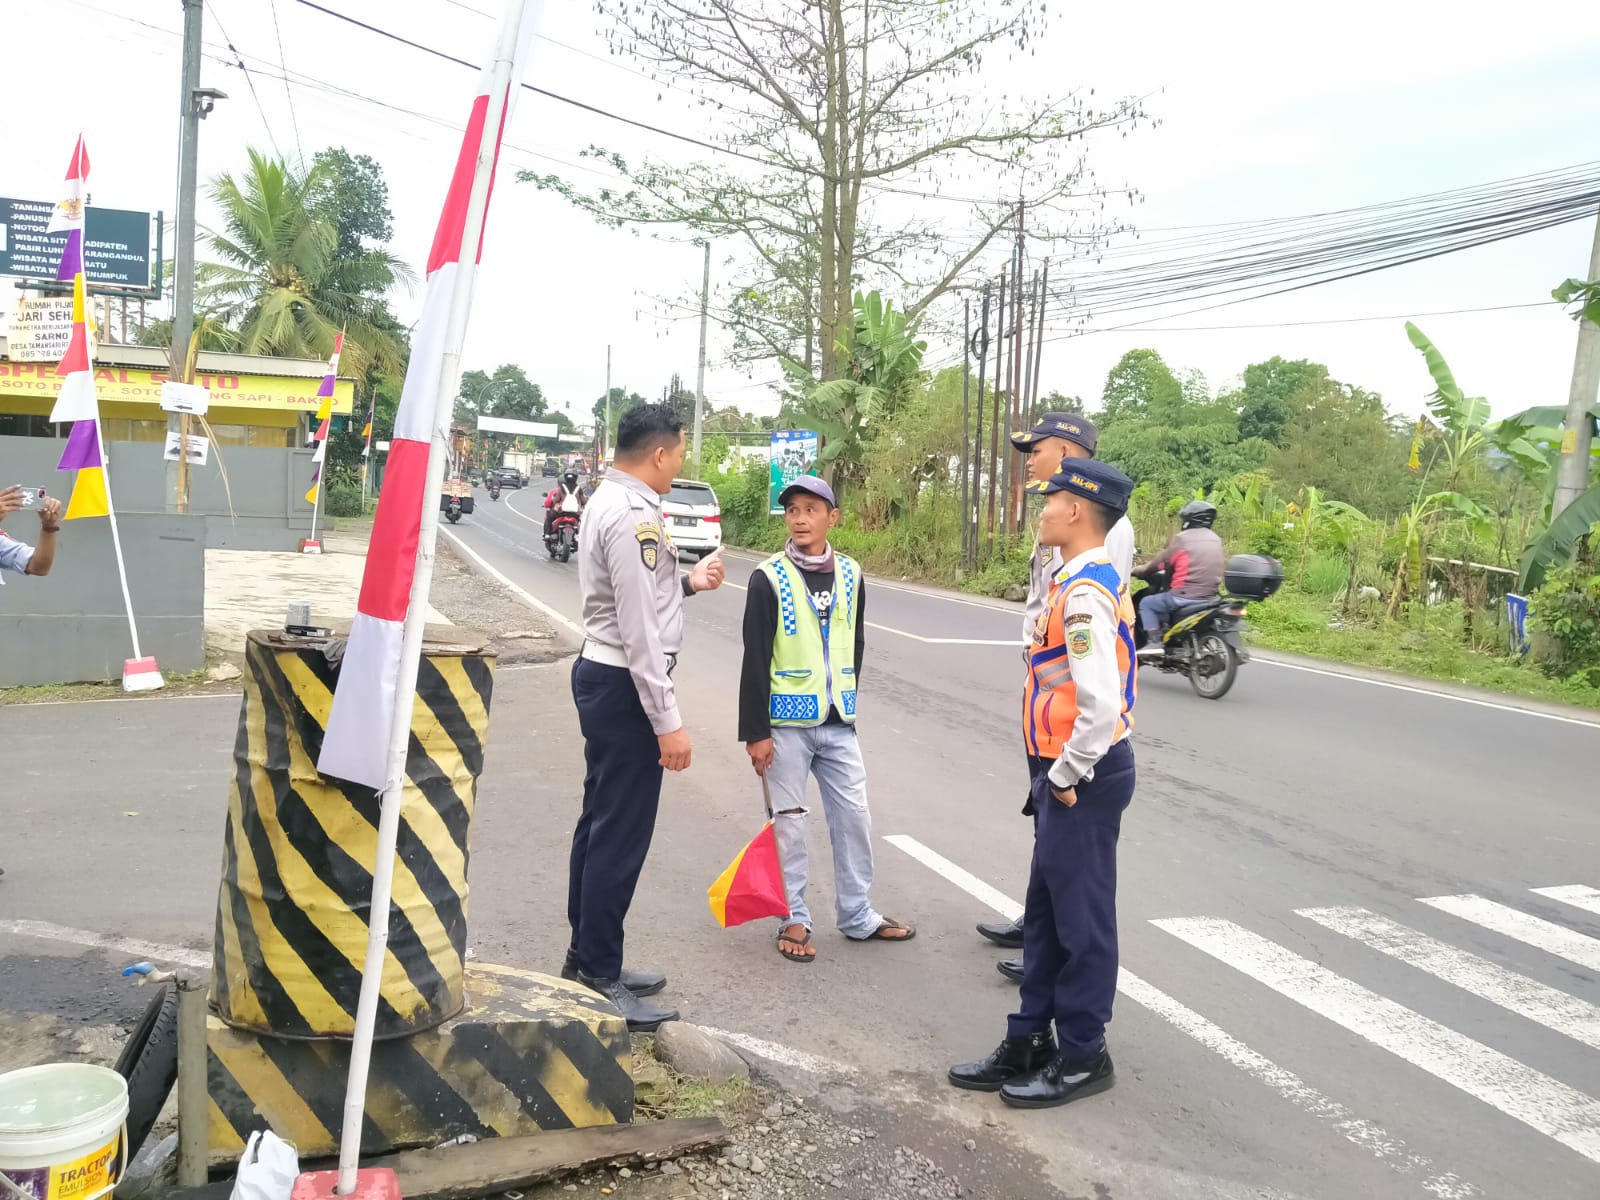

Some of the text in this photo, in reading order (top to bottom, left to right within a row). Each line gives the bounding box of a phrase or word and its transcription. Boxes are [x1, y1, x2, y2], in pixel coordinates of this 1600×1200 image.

[15, 233, 49, 243] WISATA
[84, 240, 128, 251] ADIPATEN
[15, 243, 41, 252] PASIR
[84, 250, 145, 262] ARANGANDUL
[25, 302, 51, 310] RUMAH
[35, 332, 68, 341] SARNO
[1, 380, 47, 389] SOTO
[237, 393, 272, 403] SAPI
[59, 1150, 112, 1184] TRACTOR
